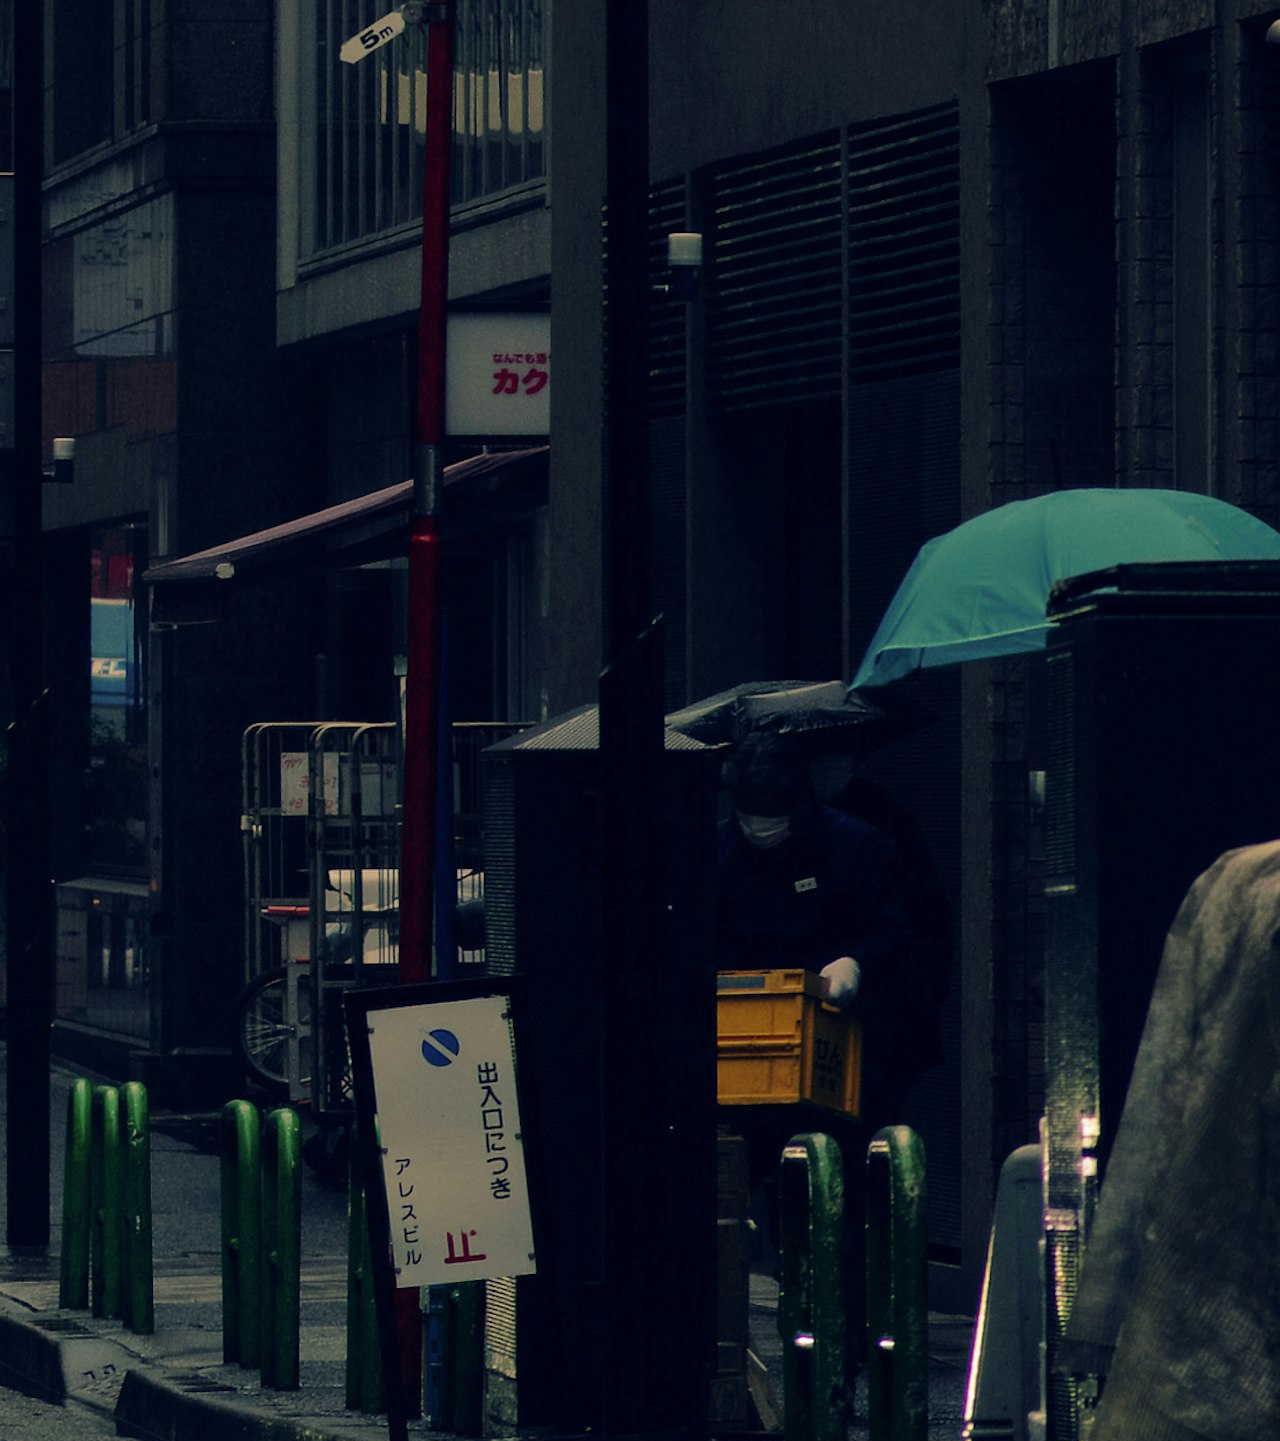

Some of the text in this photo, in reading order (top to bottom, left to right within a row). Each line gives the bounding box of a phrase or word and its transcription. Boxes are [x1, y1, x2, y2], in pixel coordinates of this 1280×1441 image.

[359, 25, 394, 49] 5m
[477, 1061, 511, 1200] 出入口につき
[394, 1157, 423, 1266] アレスビル
